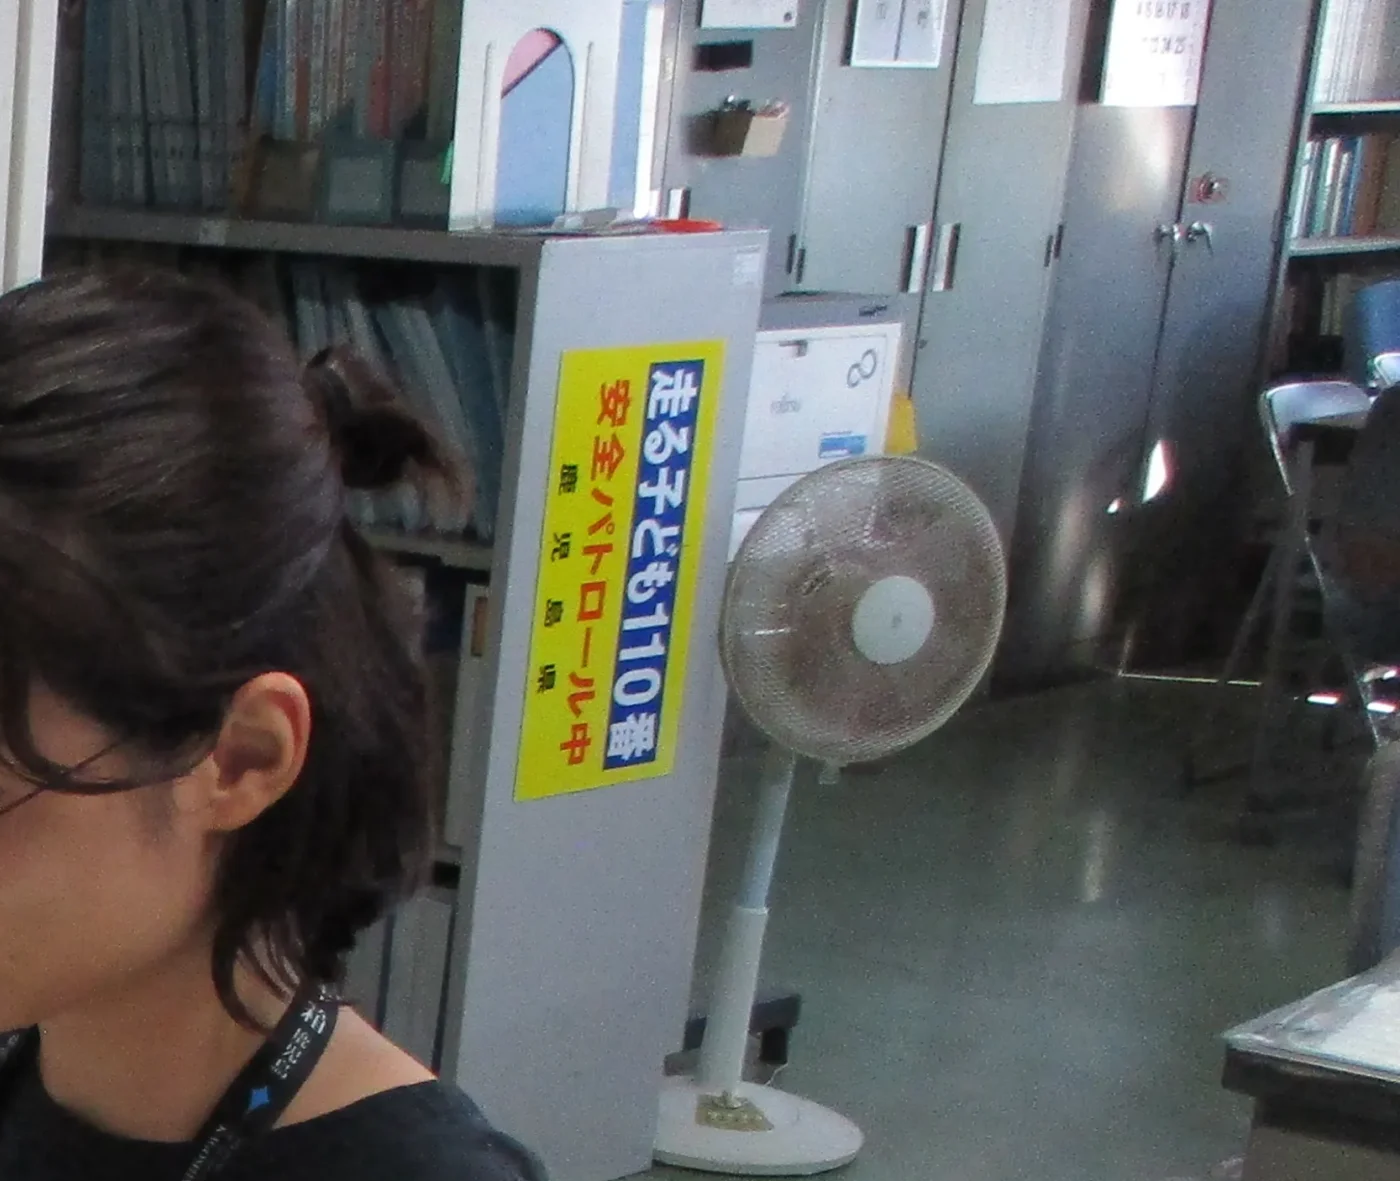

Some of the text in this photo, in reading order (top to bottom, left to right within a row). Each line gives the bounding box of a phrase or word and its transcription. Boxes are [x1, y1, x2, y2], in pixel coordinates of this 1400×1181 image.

[536, 463, 580, 694] 鹿児島県
[559, 379, 632, 766] 安全パトロール中
[605, 368, 699, 762] 走る子ども110番
